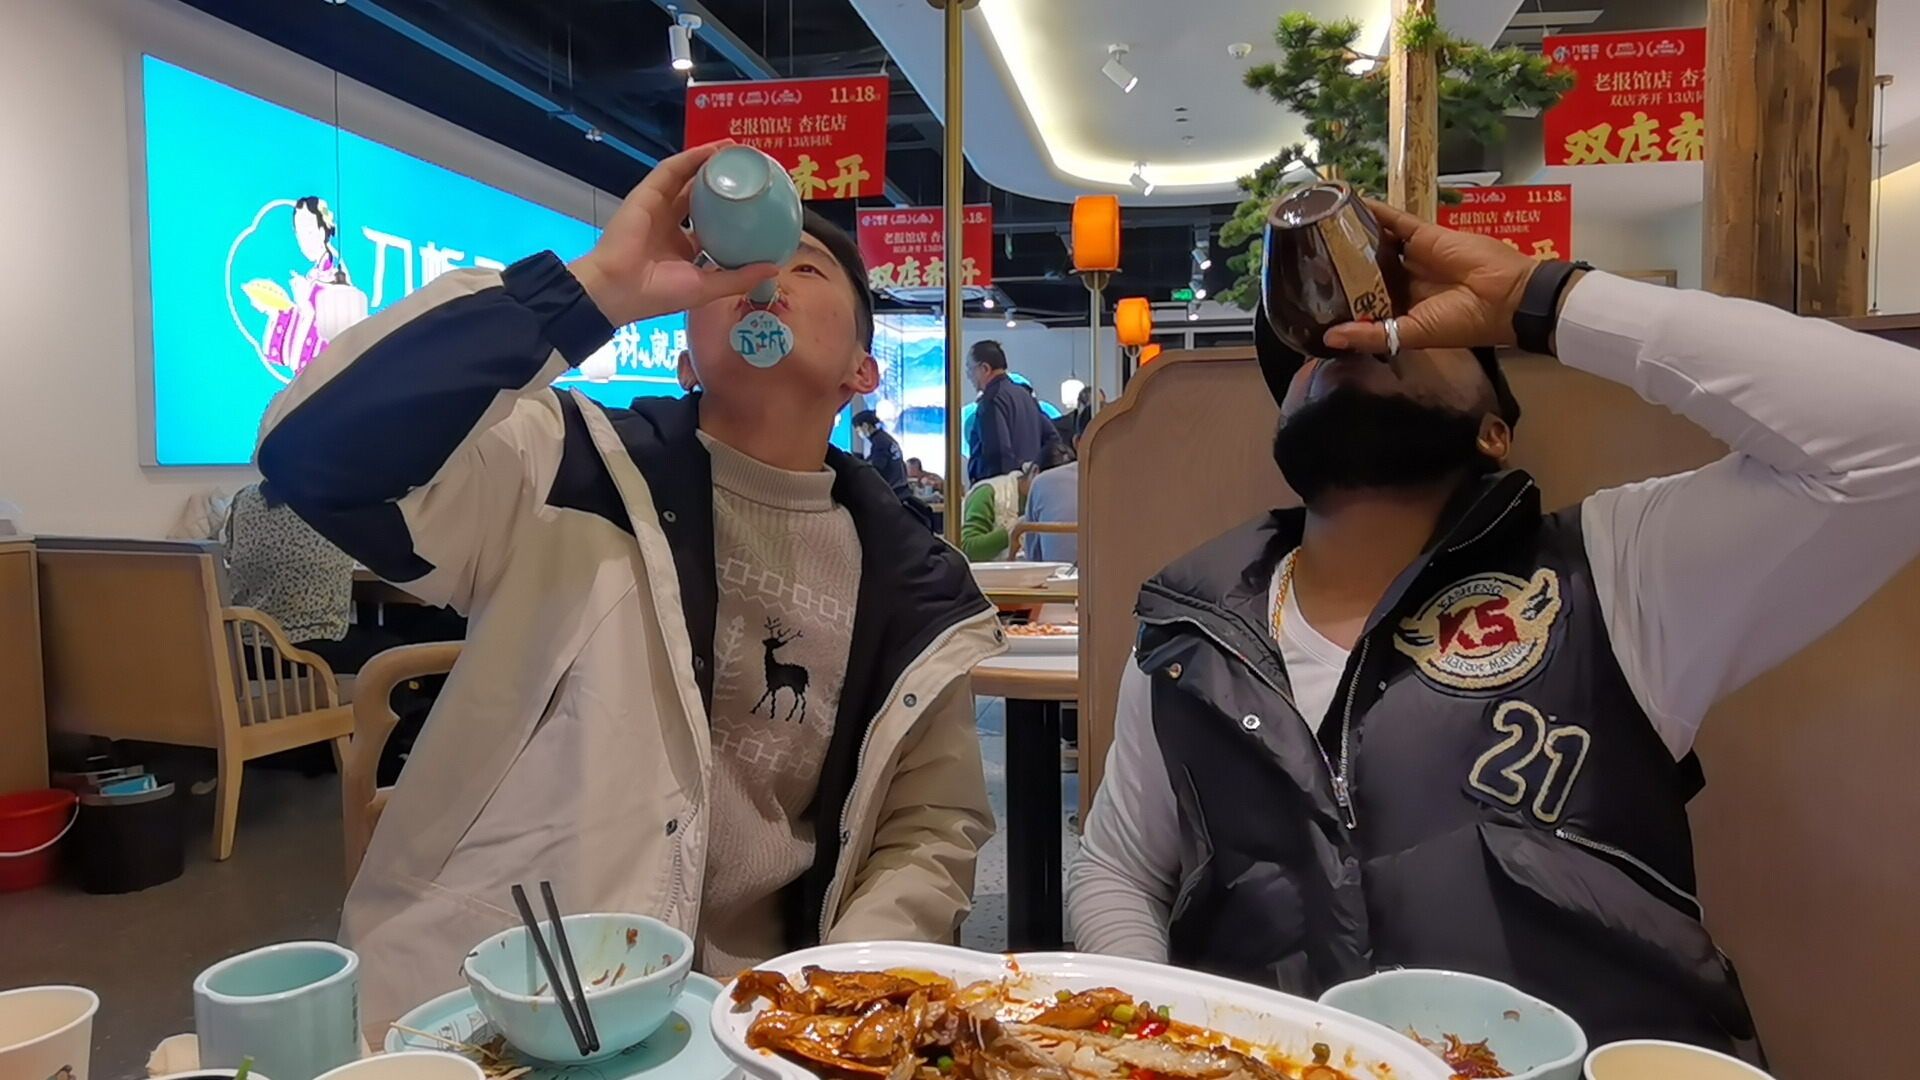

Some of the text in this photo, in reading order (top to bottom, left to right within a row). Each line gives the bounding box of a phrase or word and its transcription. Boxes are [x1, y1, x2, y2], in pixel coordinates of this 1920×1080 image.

[1594, 70, 1672, 92] 老报馆店
[799, 113, 848, 133] 杏花店
[1468, 699, 1591, 823] 21
